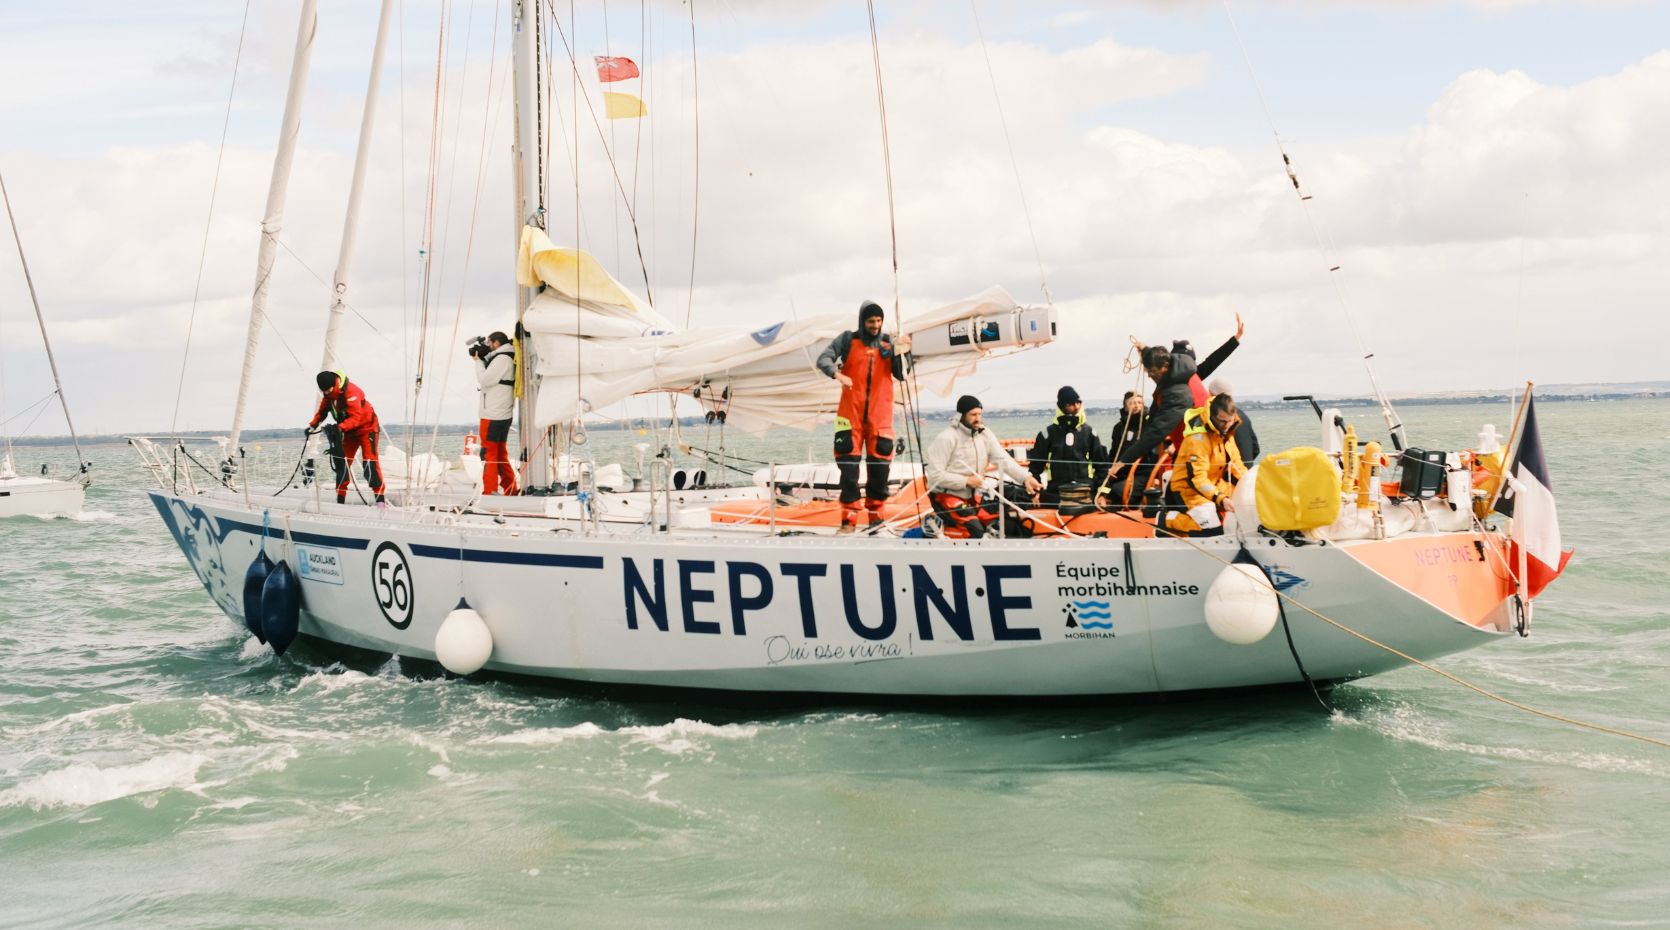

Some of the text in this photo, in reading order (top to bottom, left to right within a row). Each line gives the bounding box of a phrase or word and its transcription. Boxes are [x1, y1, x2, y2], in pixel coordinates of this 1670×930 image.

[1415, 545, 1473, 567] NEPTUNE
[1056, 561, 1120, 580] Équipe
[379, 561, 408, 611] 56
[1058, 581, 1199, 597] morbihannaise
[621, 557, 1042, 640] NEPTUNE
[1065, 632, 1116, 640] MORBIHAN
[763, 635, 809, 666] Qui
[814, 644, 845, 660] ose
